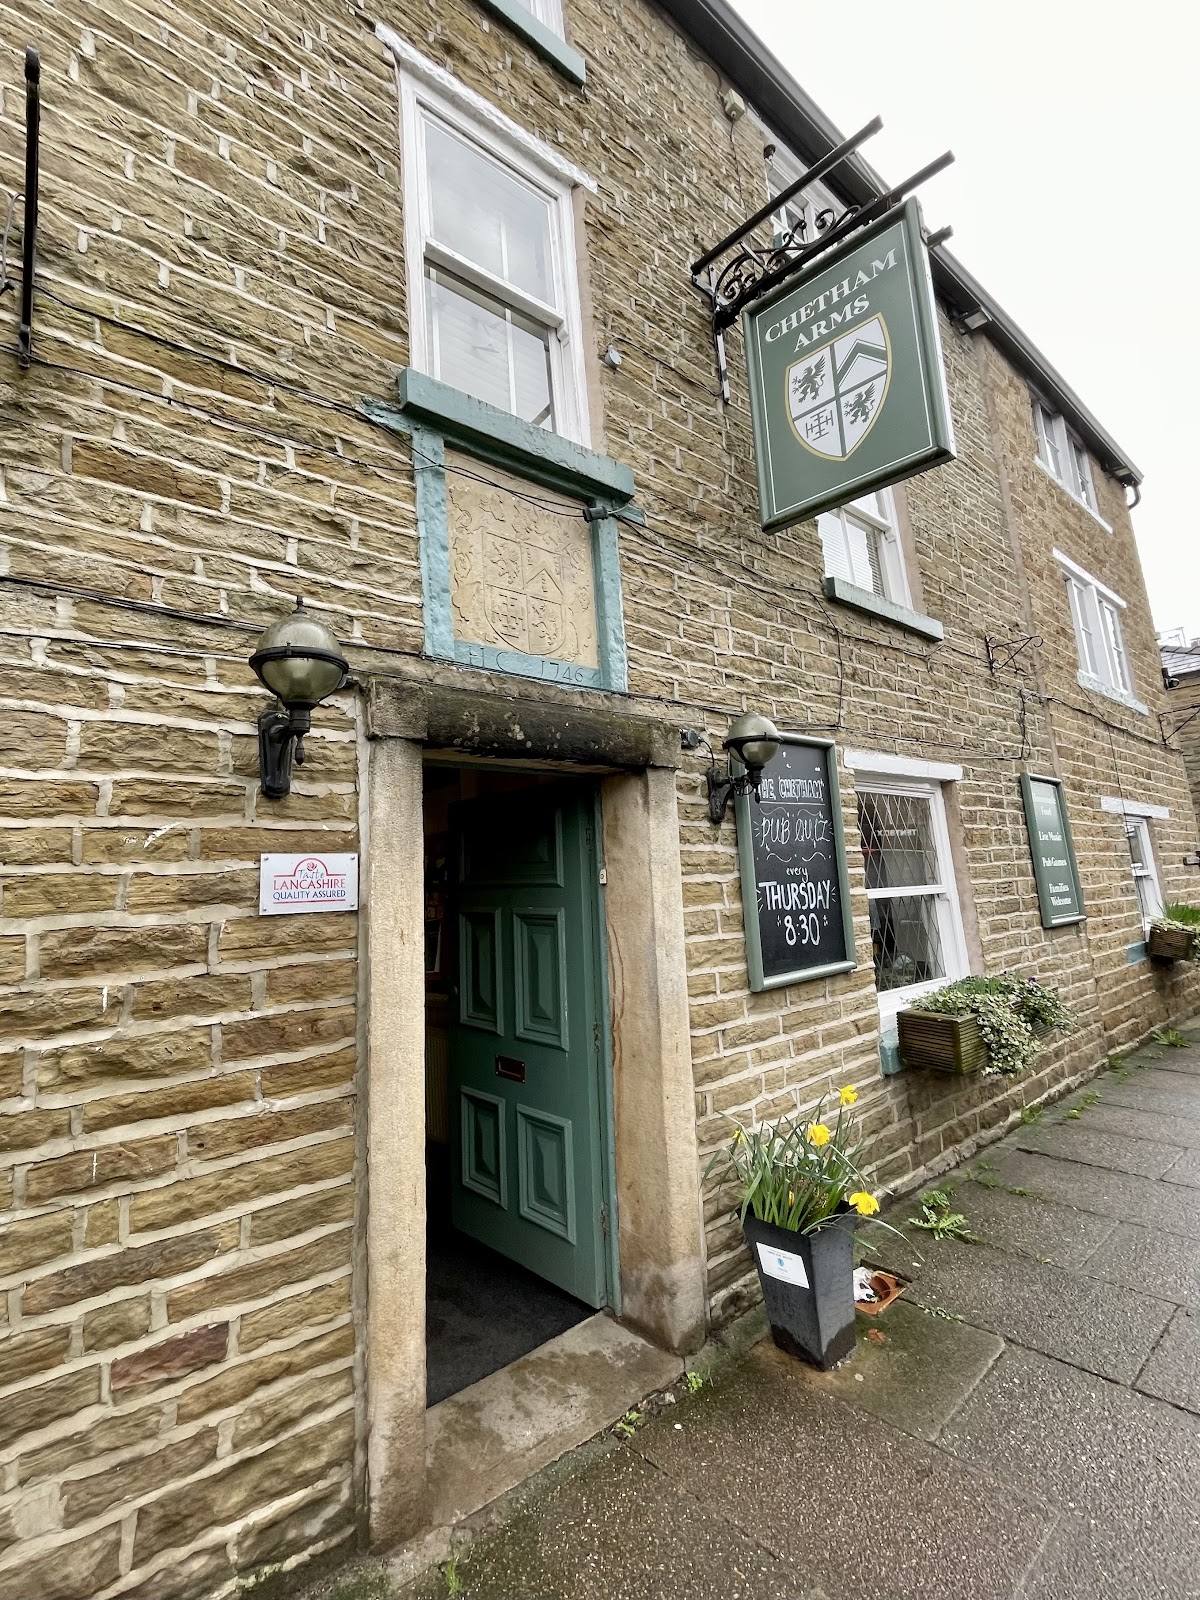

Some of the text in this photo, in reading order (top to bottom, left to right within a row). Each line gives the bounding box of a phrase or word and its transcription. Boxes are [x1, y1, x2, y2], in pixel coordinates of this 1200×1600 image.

[765, 248, 898, 343] CHETHAM
[794, 293, 870, 353] ARMS
[540, 660, 584, 683] 1746
[757, 778, 777, 800] HE
[760, 817, 831, 846] PUB QUIZ
[273, 878, 346, 891] LANCASHIRE
[297, 868, 325, 880] Taste
[786, 867, 809, 884] every
[273, 889, 346, 901] QUALITY ASSURED
[758, 880, 831, 911] THURSDAY
[784, 912, 820, 946] 8:30
